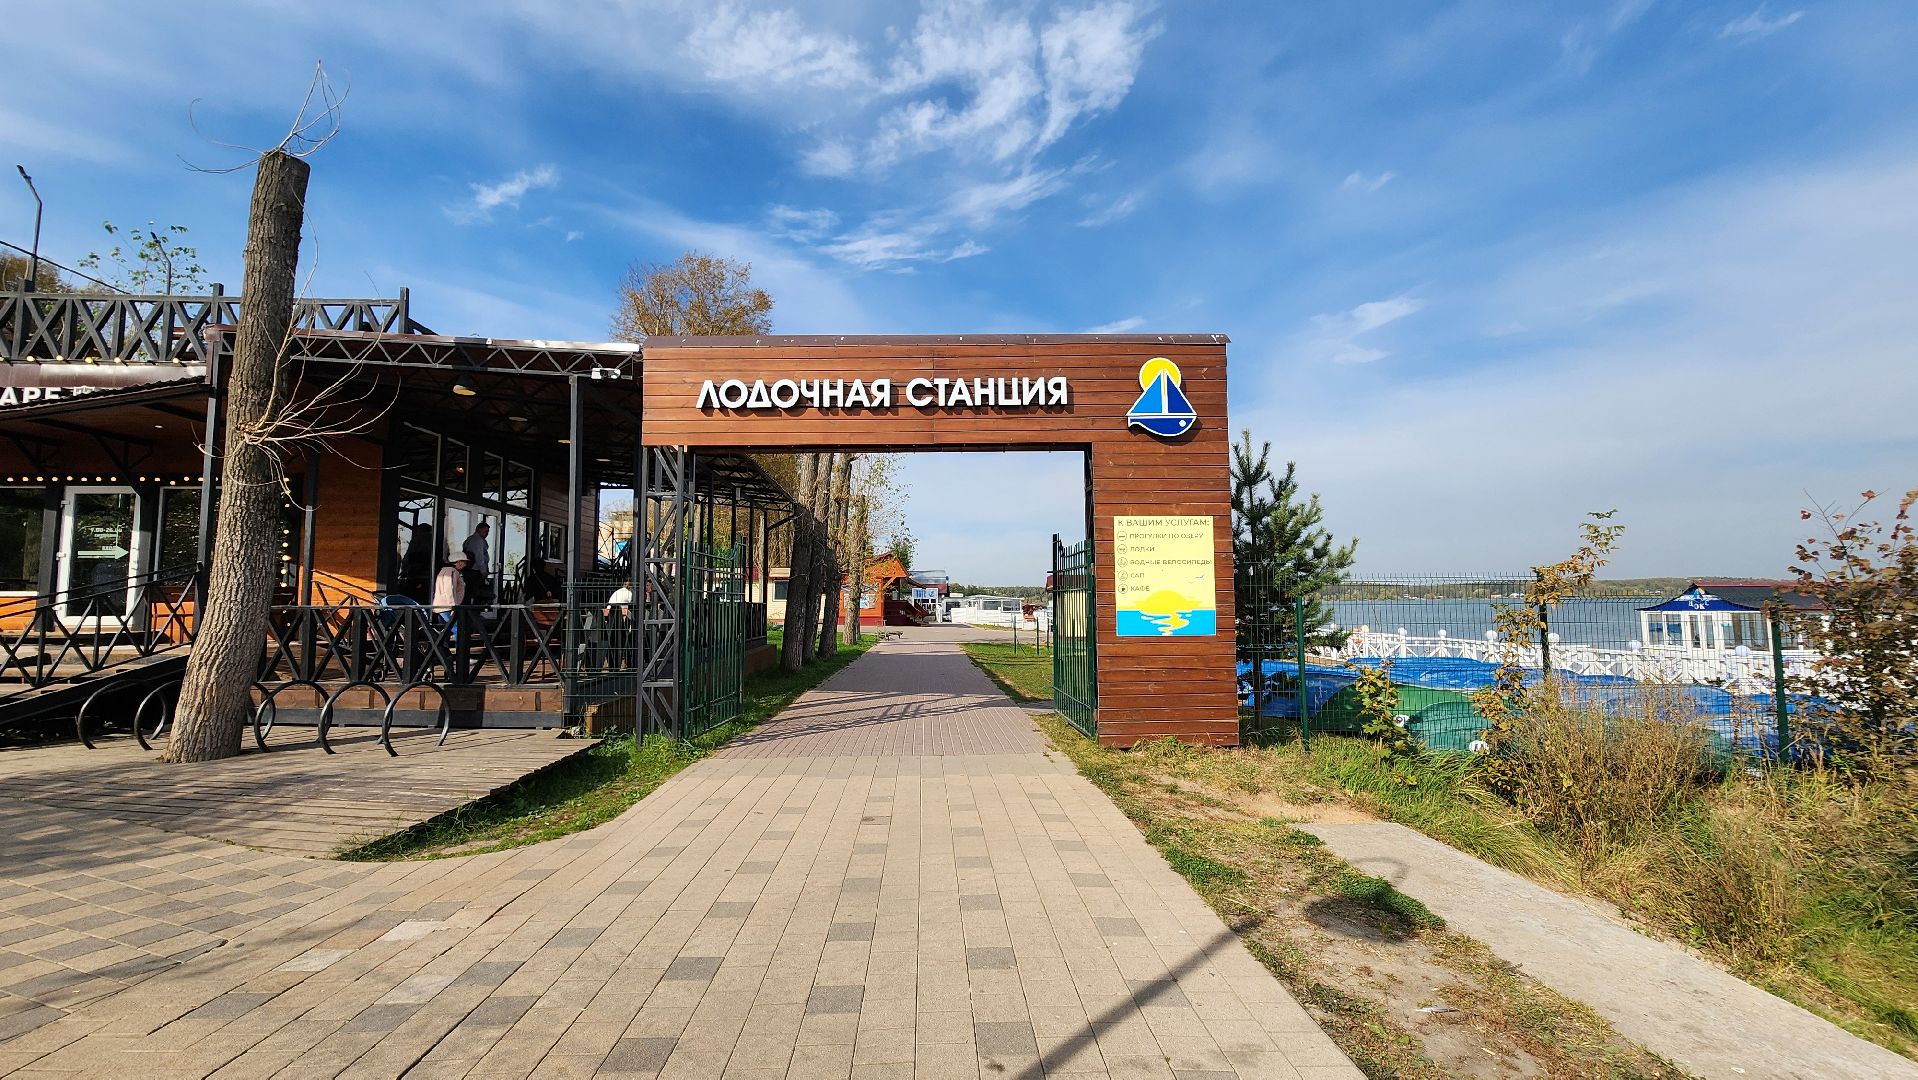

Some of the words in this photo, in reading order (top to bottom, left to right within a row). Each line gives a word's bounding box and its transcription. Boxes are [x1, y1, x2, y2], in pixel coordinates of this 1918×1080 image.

[696, 377, 890, 409] ЛОДОЧНАЯ
[906, 376, 1068, 407] СТАНЦИЯ
[1118, 519, 1124, 527] К
[1126, 519, 1163, 527] ВАШИМ
[1165, 518, 1210, 527] УСЛУГАМ:
